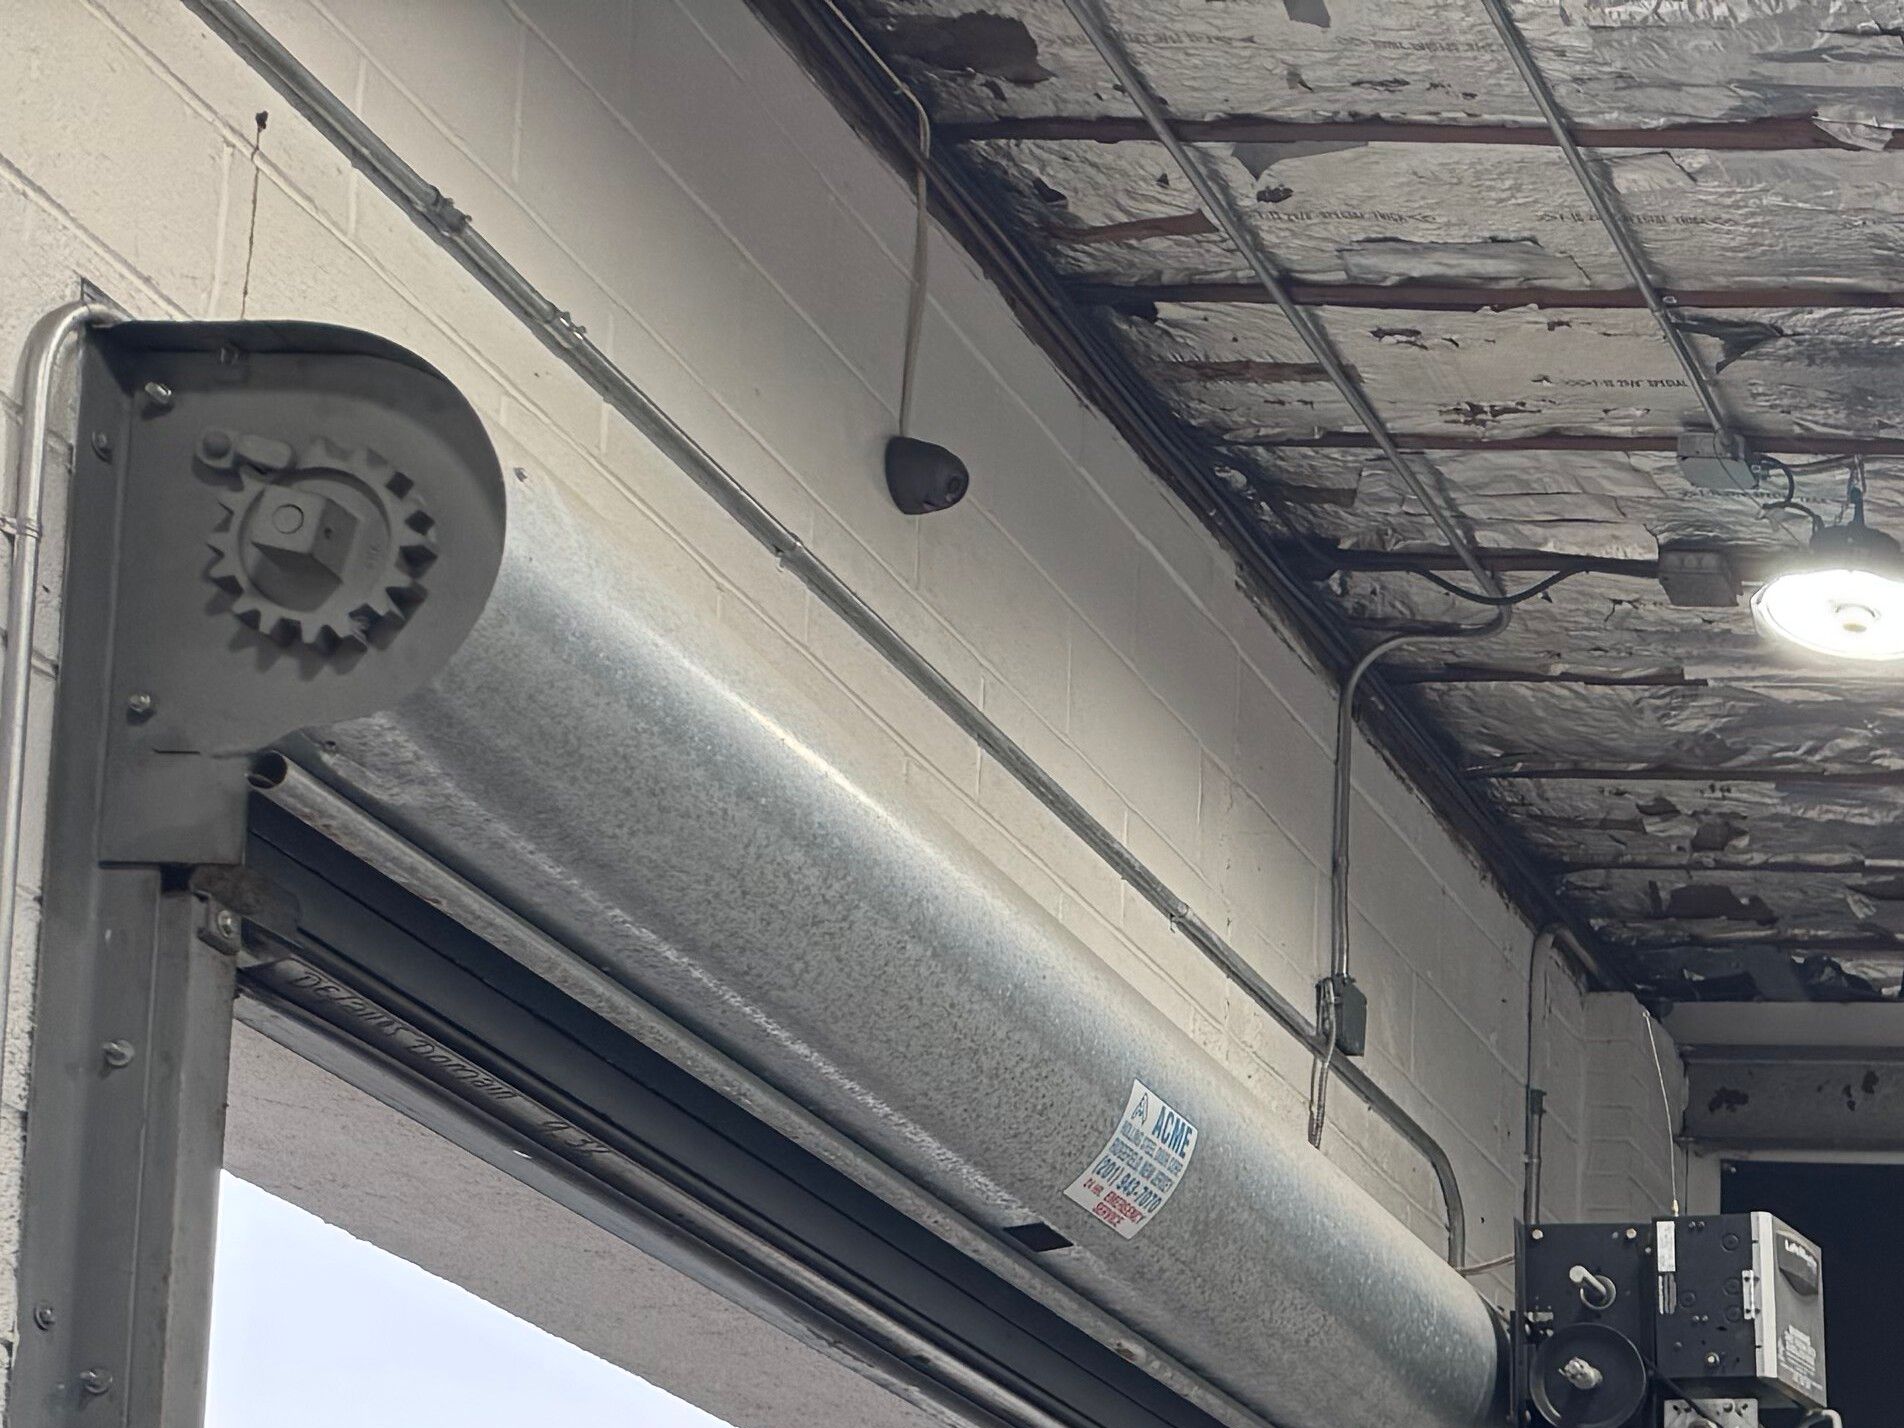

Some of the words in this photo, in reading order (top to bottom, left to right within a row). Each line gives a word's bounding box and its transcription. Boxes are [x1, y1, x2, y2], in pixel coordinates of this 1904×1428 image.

[1152, 1105, 1194, 1159] ACME
[1092, 1155, 1125, 1187] (201)
[1115, 1172, 1163, 1214] 943-7070
